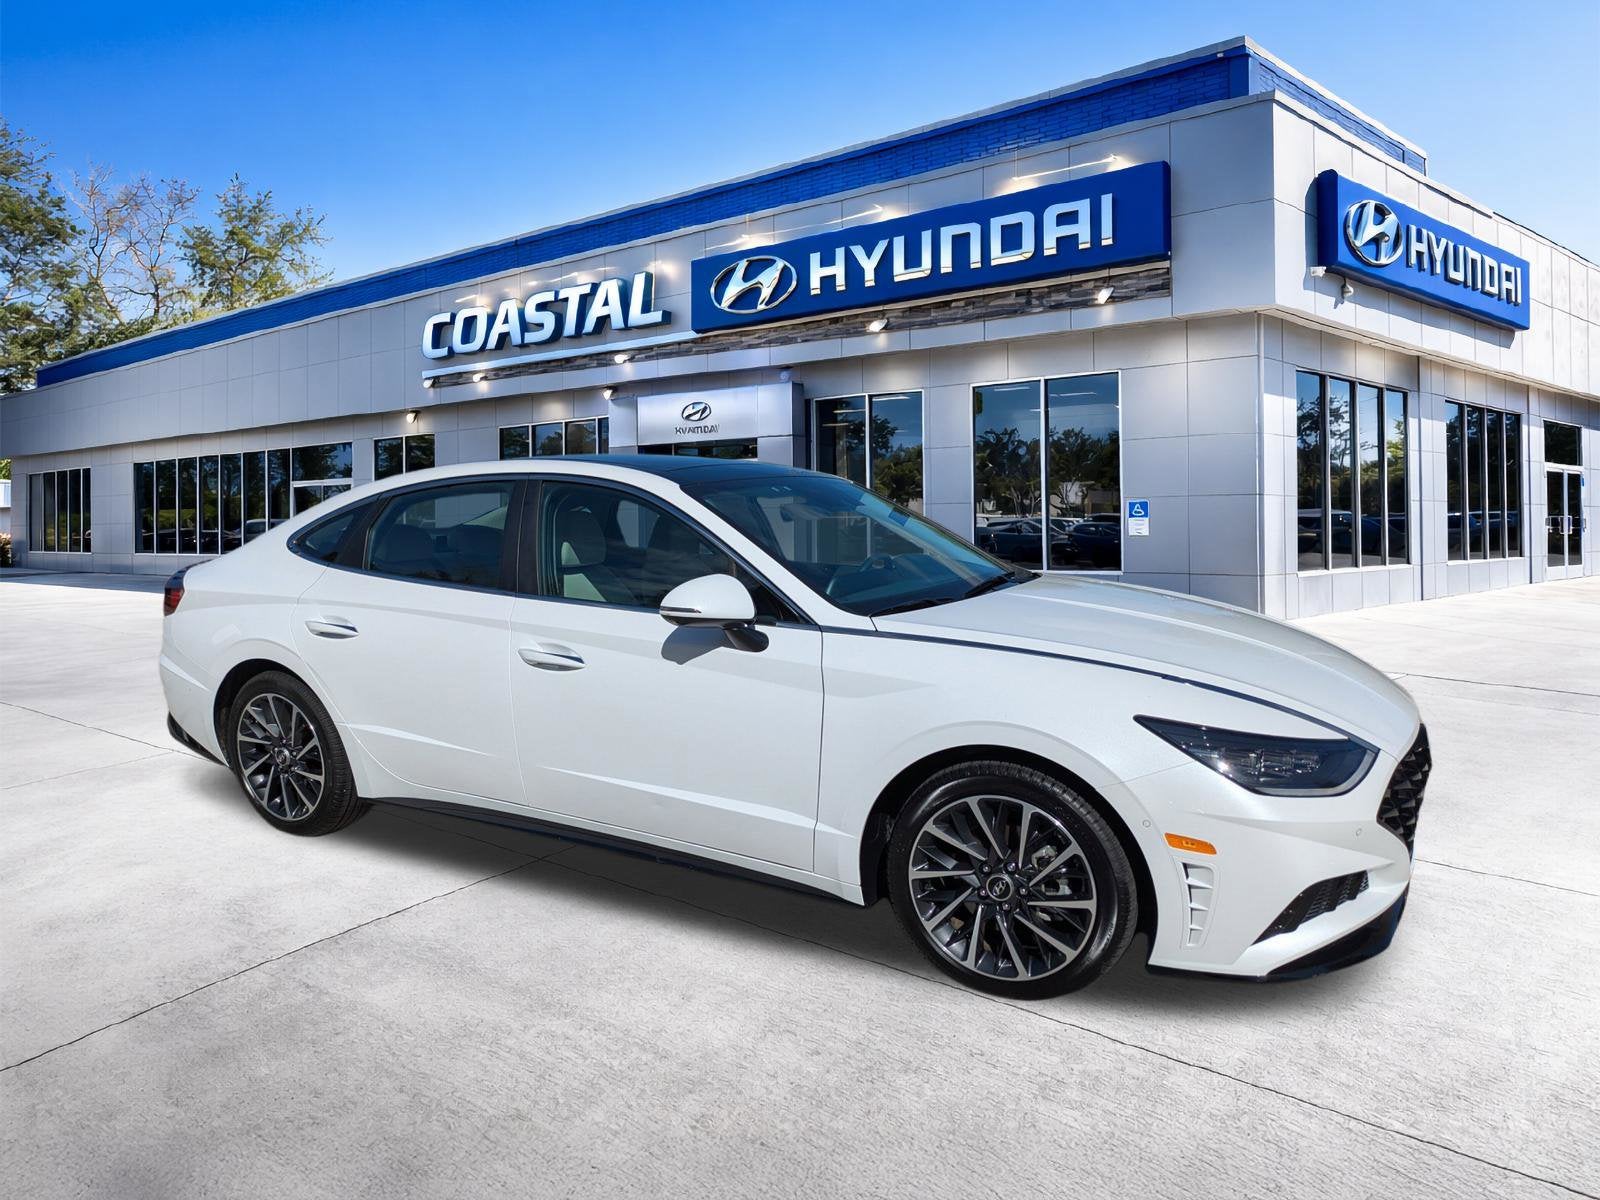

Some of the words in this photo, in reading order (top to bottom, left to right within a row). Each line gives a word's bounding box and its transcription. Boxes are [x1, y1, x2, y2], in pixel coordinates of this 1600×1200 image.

[810, 193, 1113, 296] HYUNDAI
[1406, 224, 1522, 307] HYUNDAI
[421, 271, 672, 360] COASTAL
